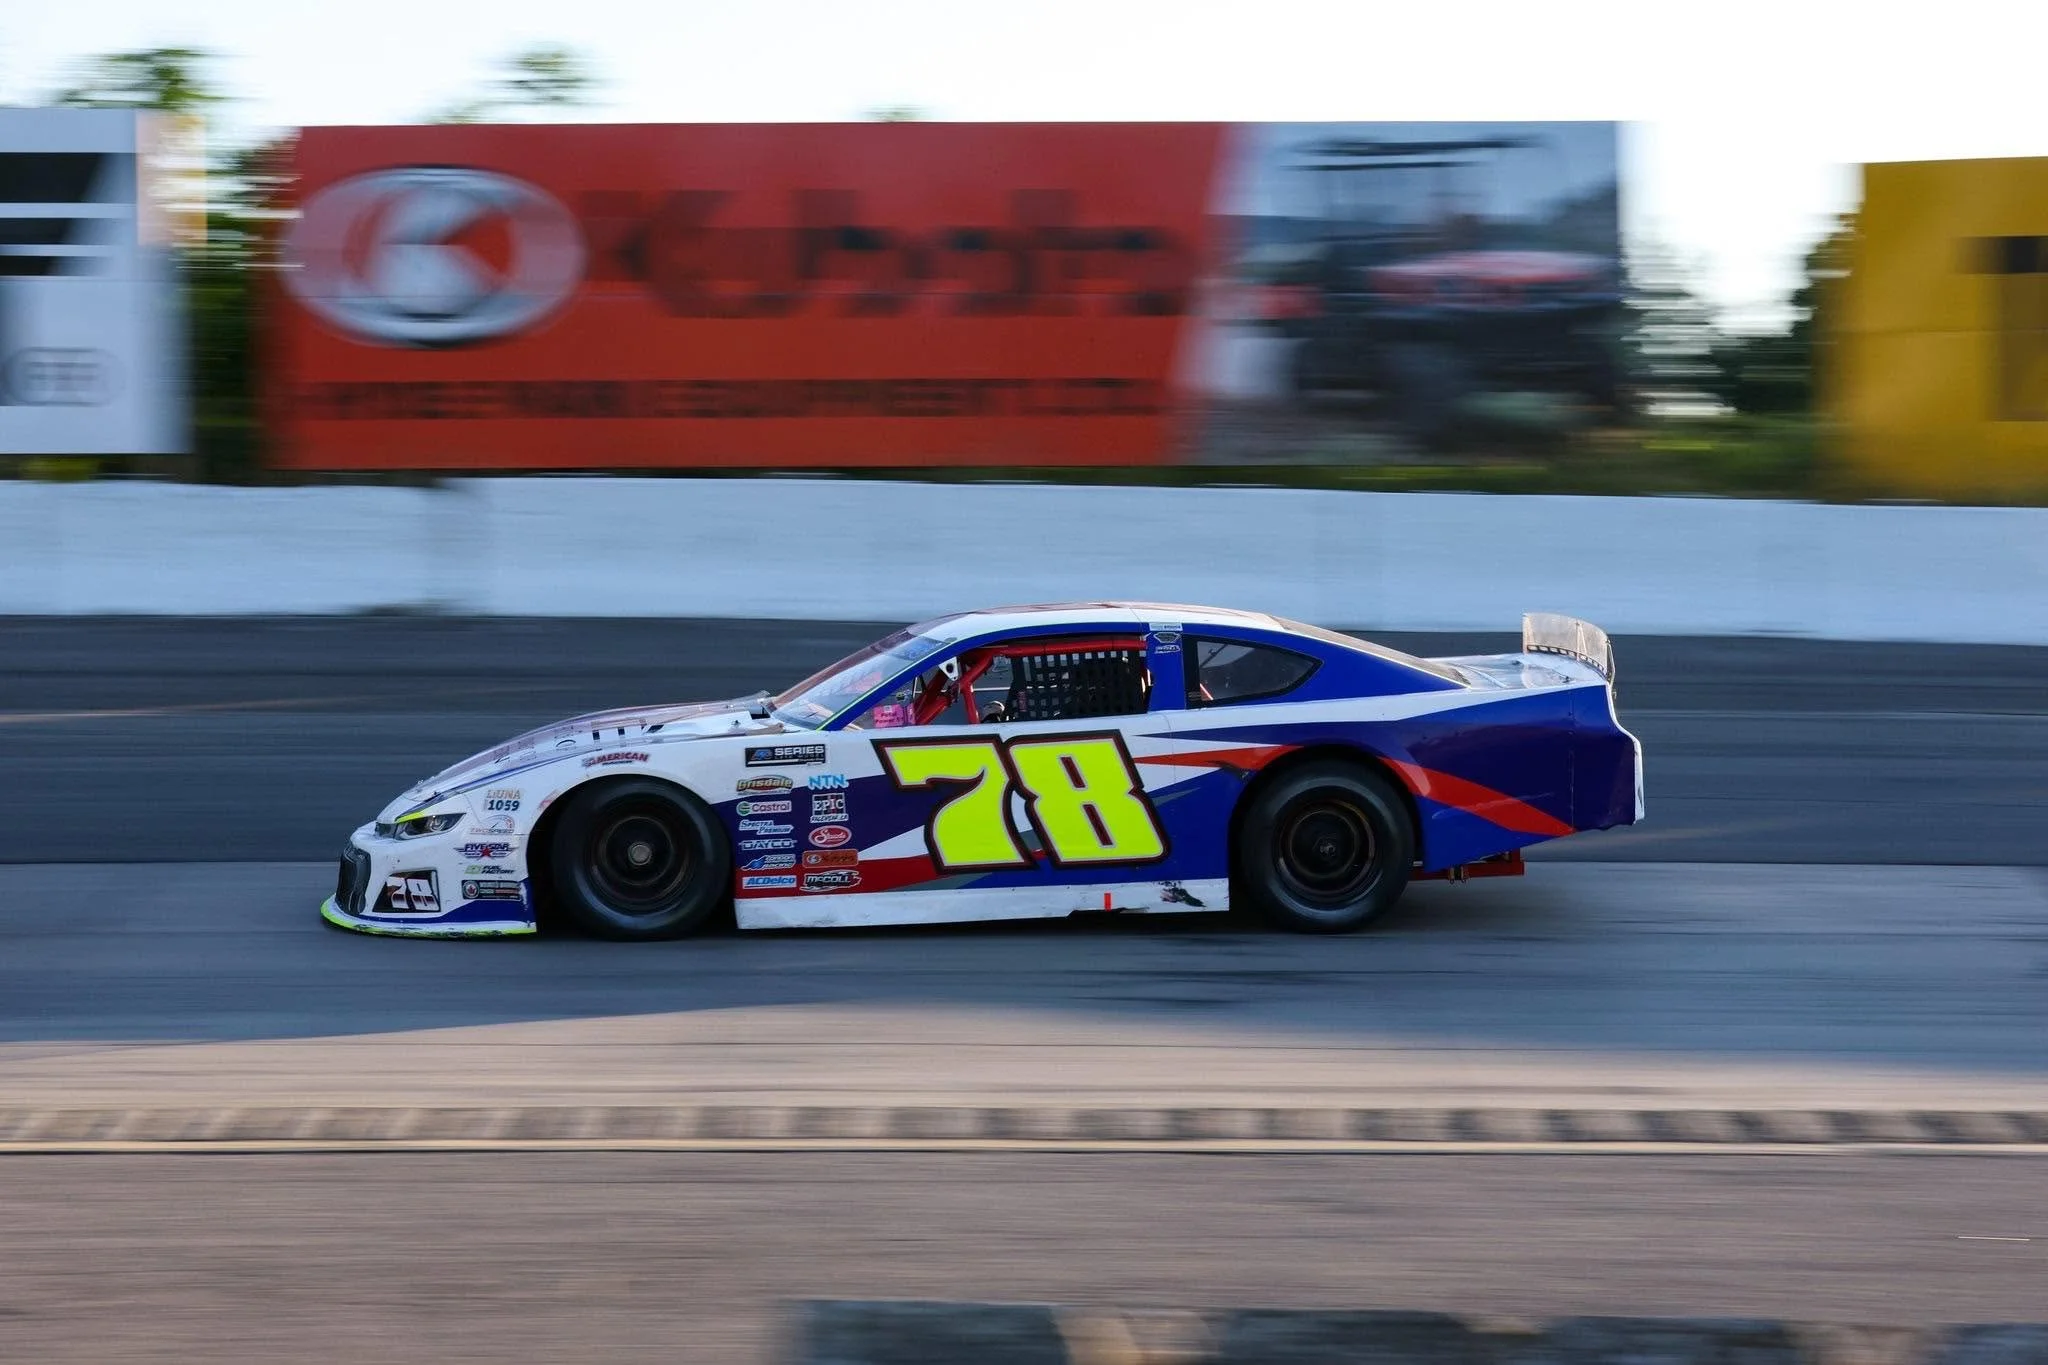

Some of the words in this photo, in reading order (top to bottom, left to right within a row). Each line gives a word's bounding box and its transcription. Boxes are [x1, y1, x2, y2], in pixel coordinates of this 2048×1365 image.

[774, 746, 824, 756] SERIES
[809, 775, 846, 788] NTN
[488, 800, 520, 811] 1059
[751, 802, 790, 812] Castrol
[813, 798, 845, 811] EPIC
[871, 730, 1171, 873] 78
[743, 840, 792, 849] DAYCO
[747, 877, 796, 885] ACDelco
[386, 876, 440, 911] 78
